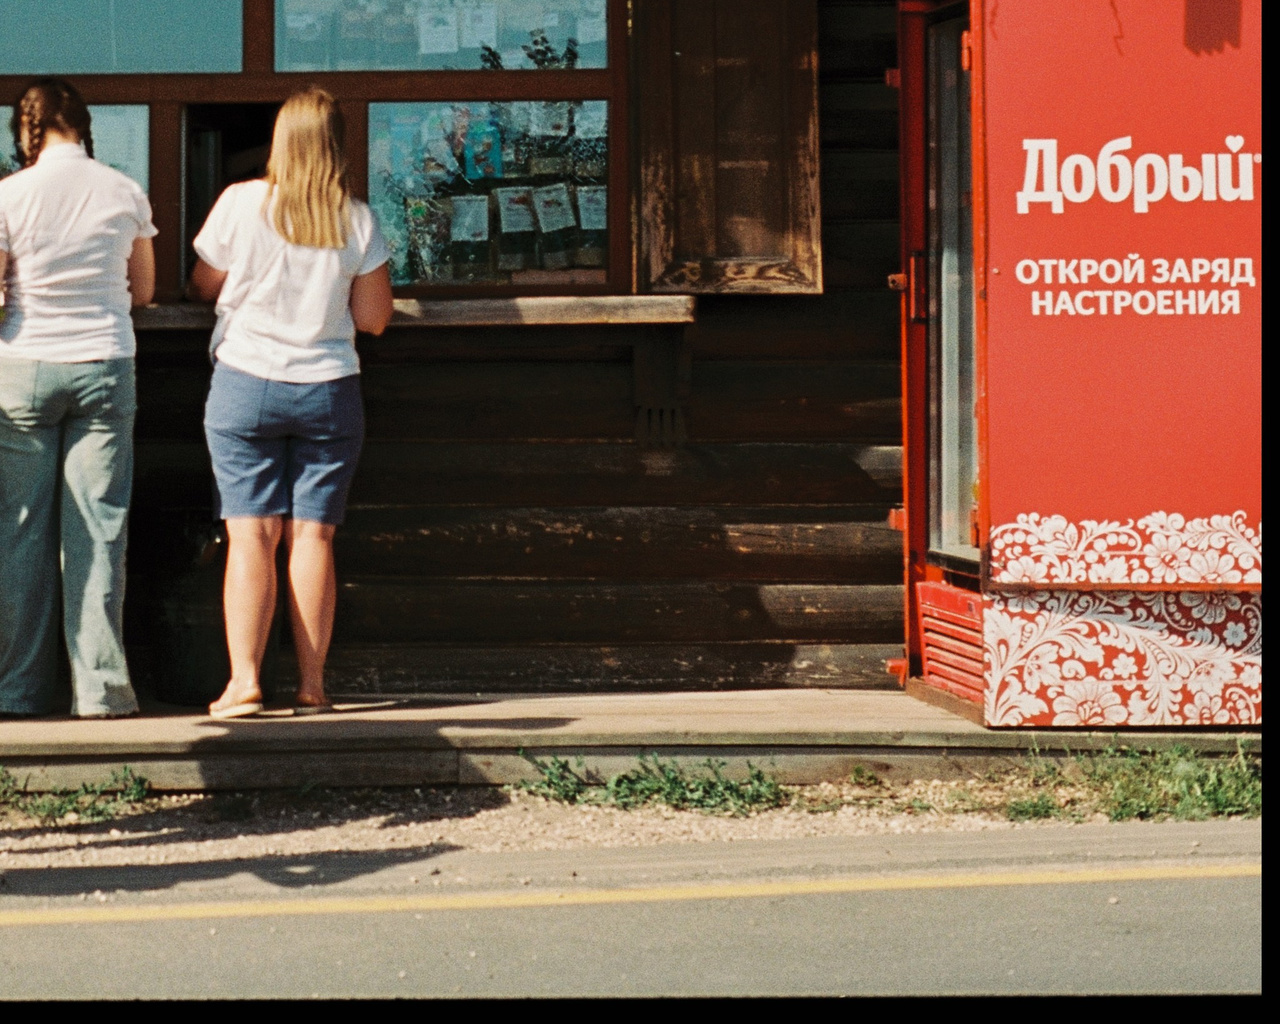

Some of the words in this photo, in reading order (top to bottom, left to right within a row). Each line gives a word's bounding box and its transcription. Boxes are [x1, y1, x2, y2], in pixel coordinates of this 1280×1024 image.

[1015, 134, 1254, 214] Добрый
[1015, 253, 1145, 285] ОТКРОЙ
[1151, 257, 1256, 287] ЗАРЯД
[1031, 290, 1241, 316] НАСТРОЕНИЯ
